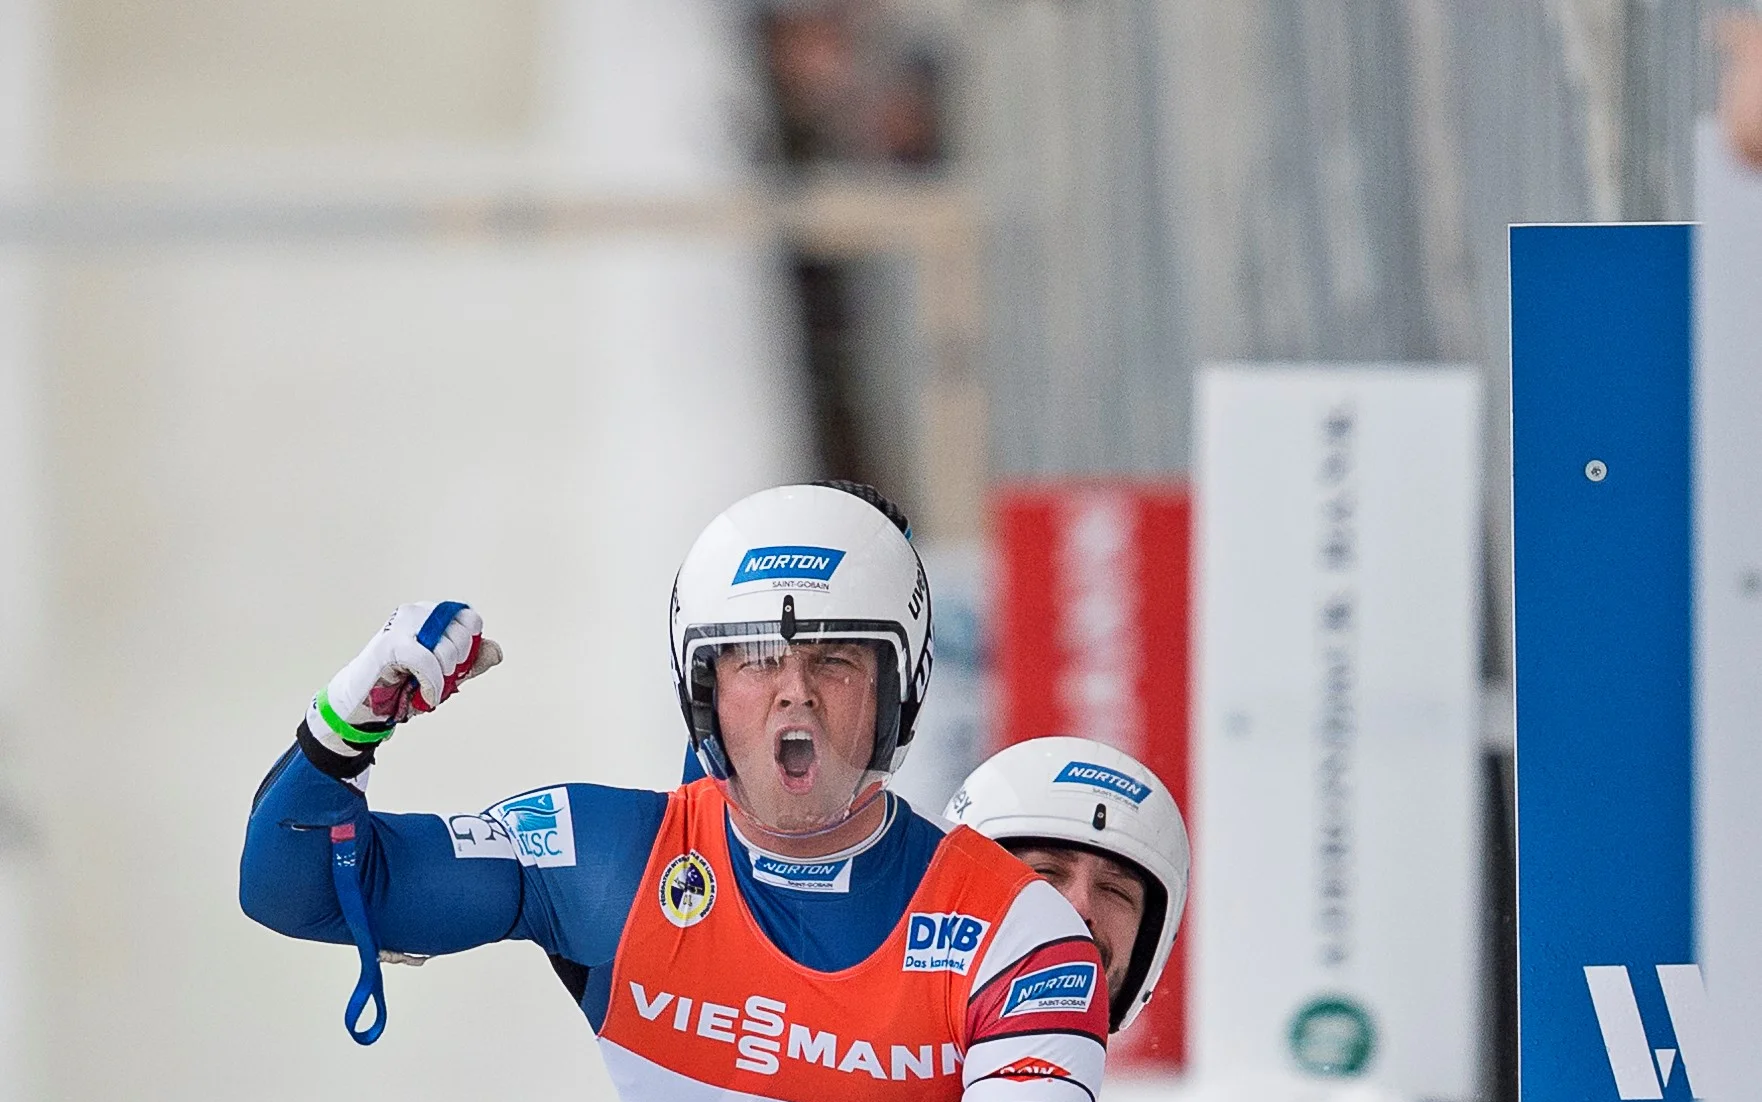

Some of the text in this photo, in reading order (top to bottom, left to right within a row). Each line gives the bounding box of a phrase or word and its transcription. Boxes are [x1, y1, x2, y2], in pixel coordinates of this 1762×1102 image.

[745, 554, 830, 573] NORTON
[772, 580, 830, 591] SAINT-GOBAIN
[1068, 766, 1142, 795] NORTON
[763, 862, 835, 875] NORTON
[908, 916, 983, 952] DKB
[905, 956, 927, 968] Das
[1018, 974, 1087, 1003] NORTON
